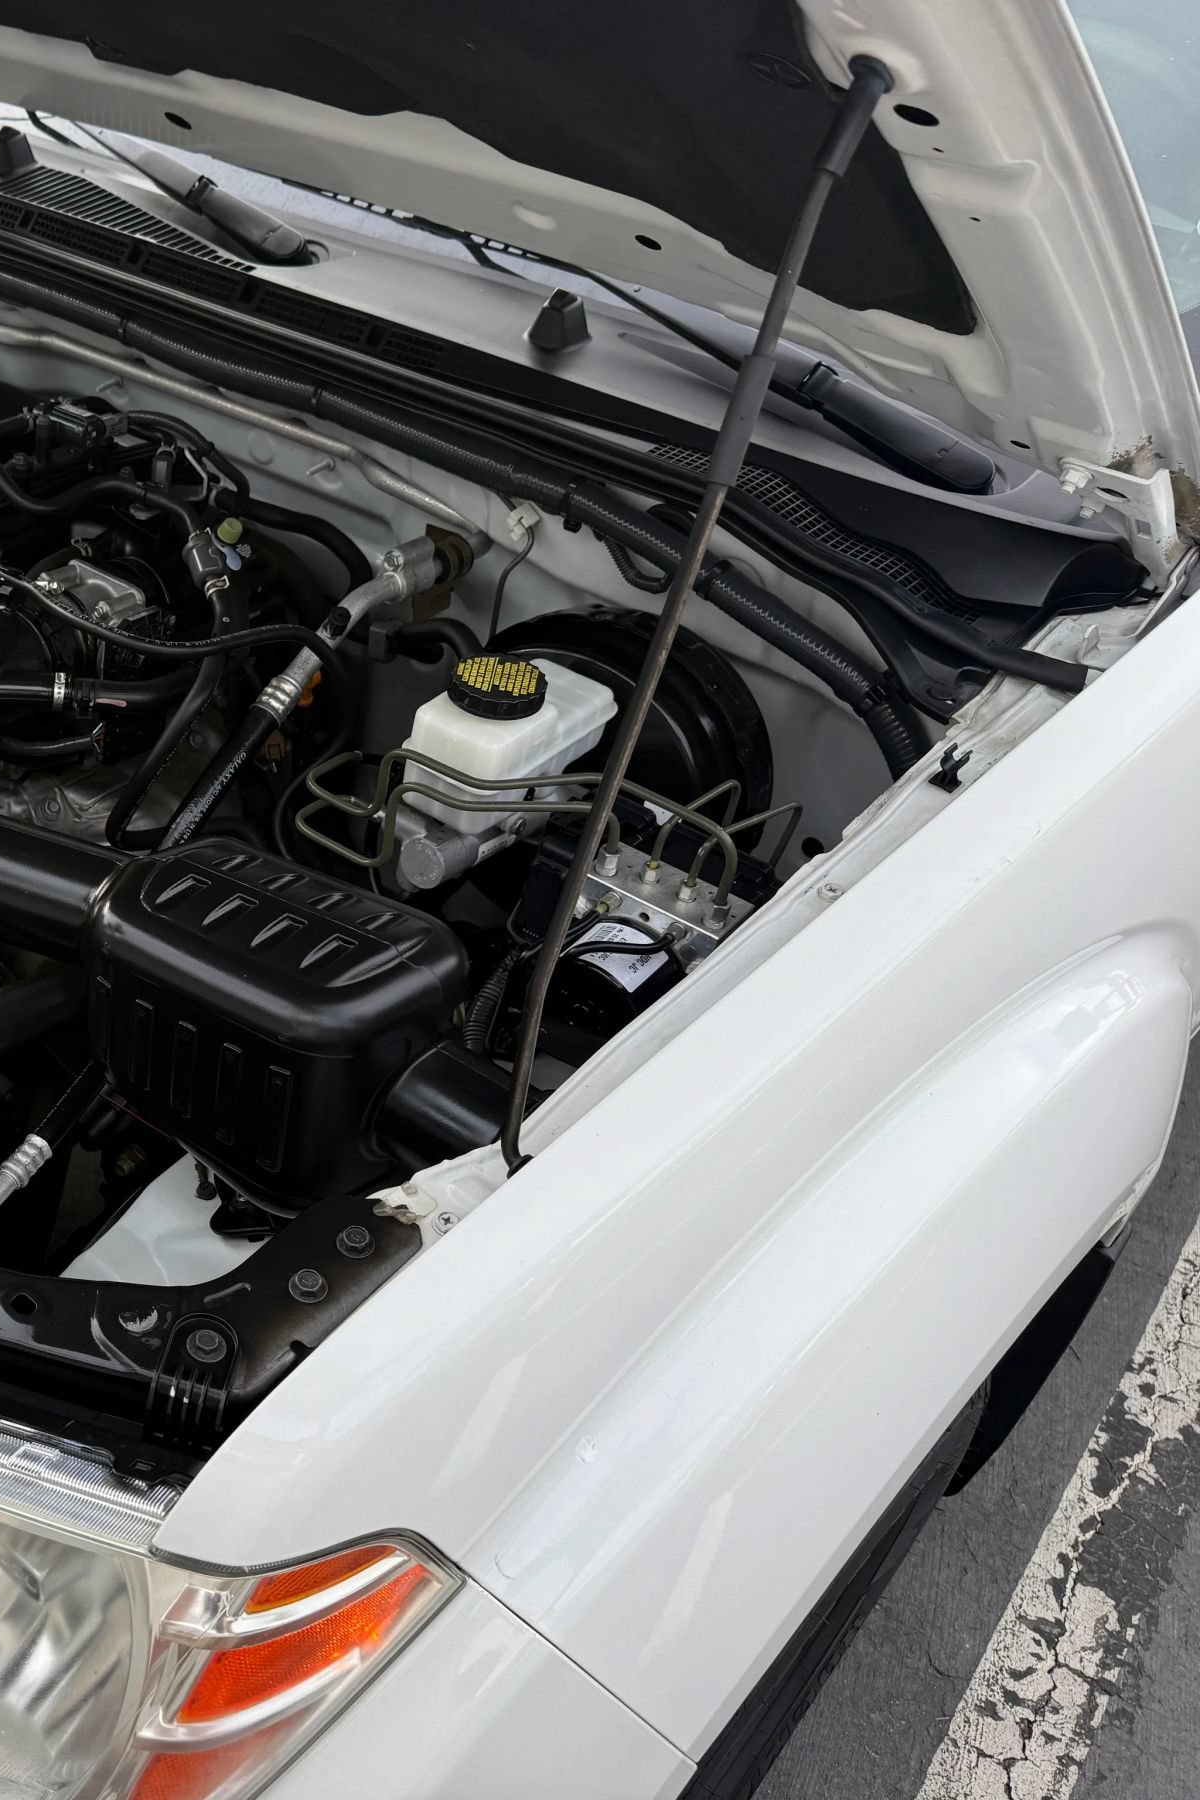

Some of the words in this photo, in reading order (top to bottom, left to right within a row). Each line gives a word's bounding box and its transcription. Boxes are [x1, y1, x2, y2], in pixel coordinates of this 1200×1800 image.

[222, 751, 247, 785] GALAXY
[635, 954, 653, 967] VDC
[628, 962, 639, 974] JC
